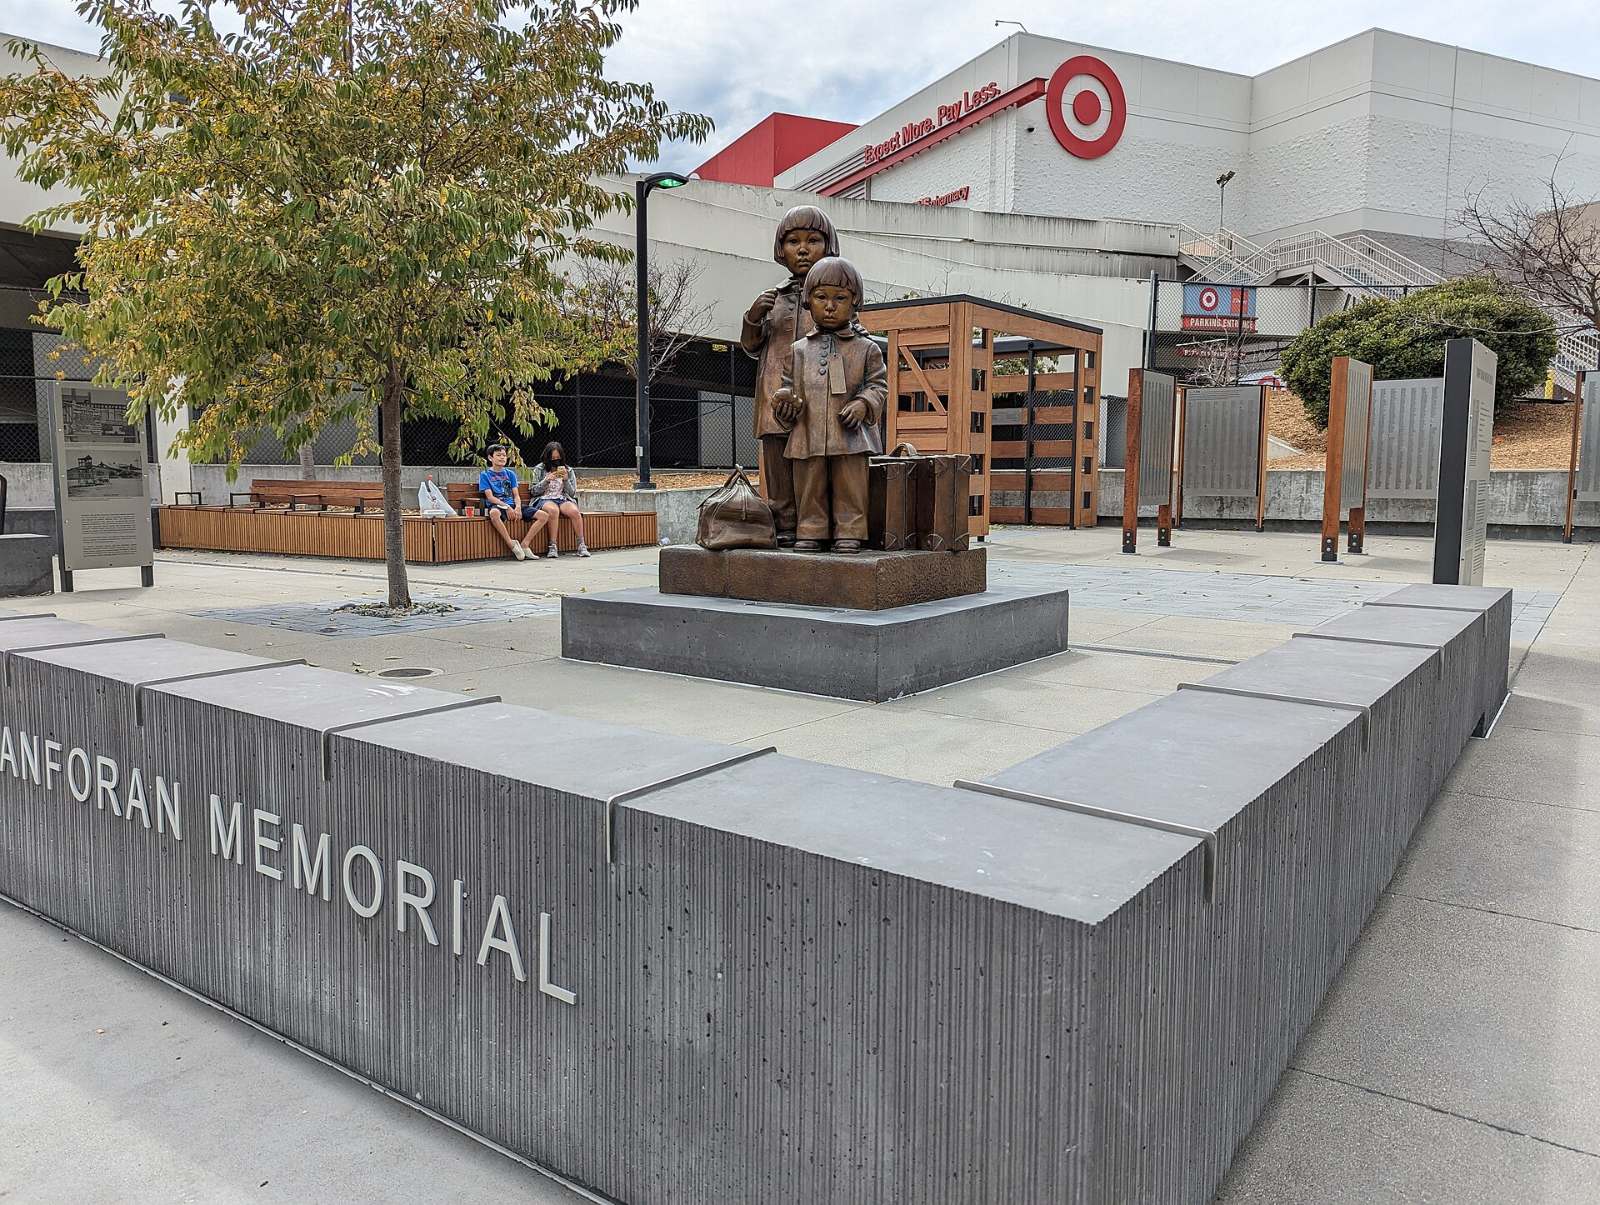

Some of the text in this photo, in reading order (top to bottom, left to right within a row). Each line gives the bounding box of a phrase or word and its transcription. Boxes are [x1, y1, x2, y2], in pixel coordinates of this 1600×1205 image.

[865, 82, 1001, 163] Expect More. Pay Less.
[1190, 317, 1255, 330] PARKING ENTRNCE
[210, 794, 577, 1005] MEMORIAL
